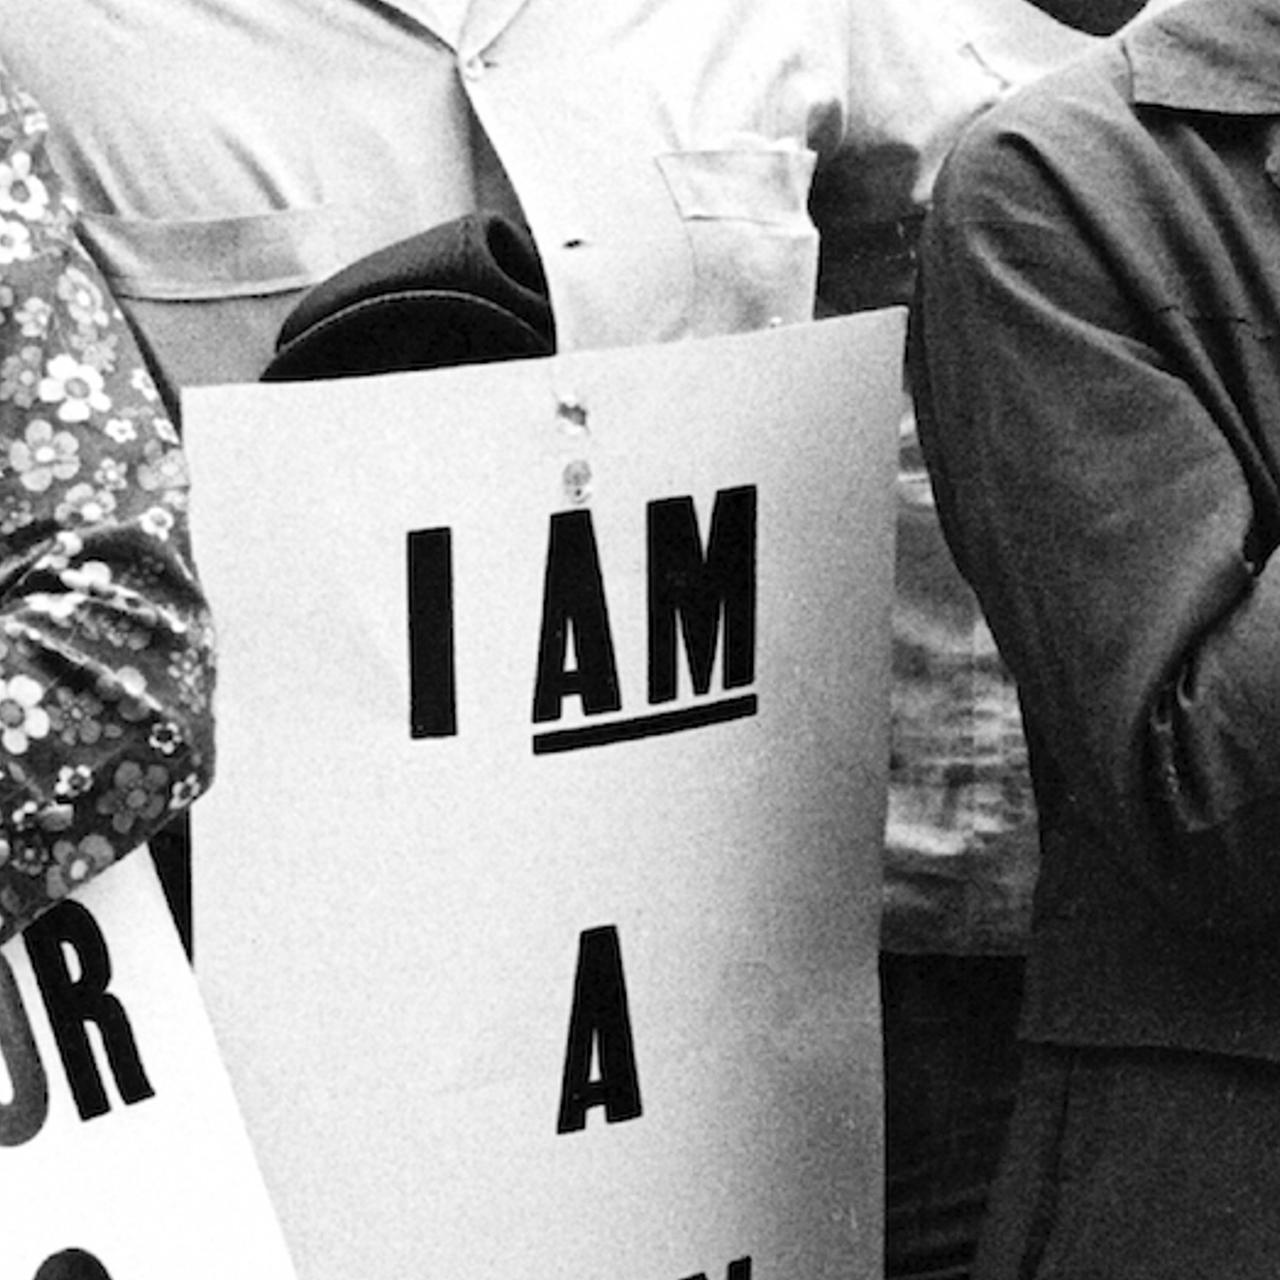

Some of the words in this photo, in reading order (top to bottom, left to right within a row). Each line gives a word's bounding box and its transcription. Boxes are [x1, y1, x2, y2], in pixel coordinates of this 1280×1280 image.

[407, 527, 458, 740] I
[532, 484, 758, 724] AM
[557, 924, 643, 1135] A
